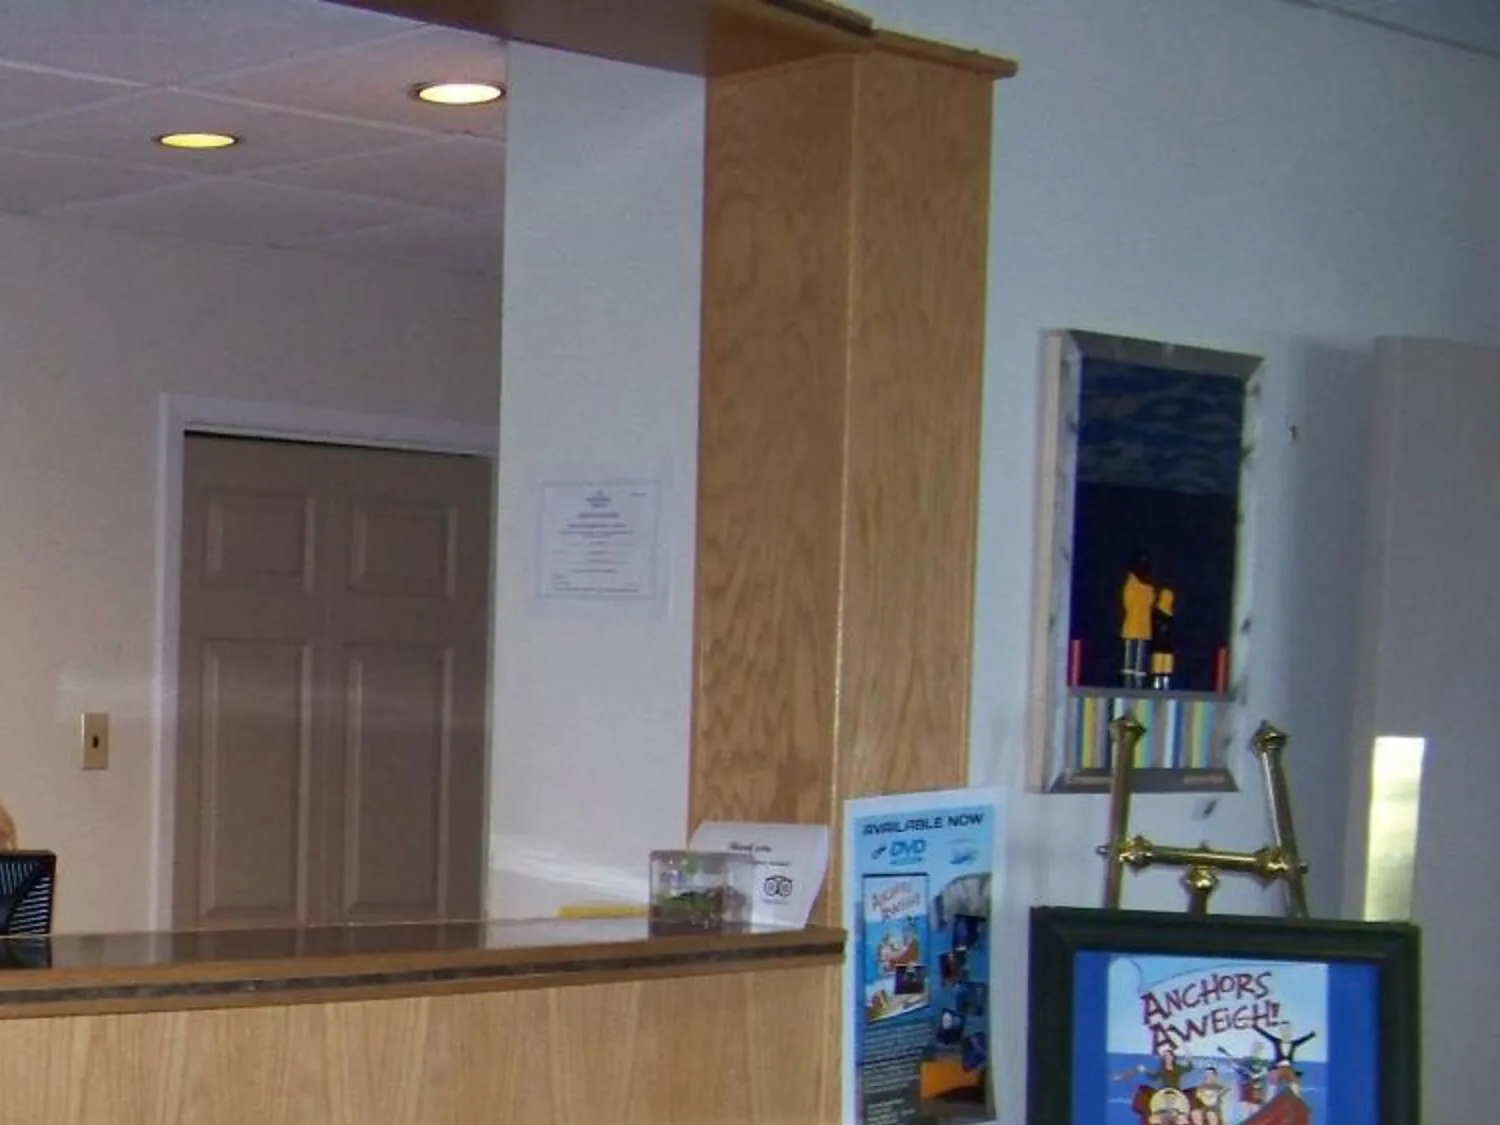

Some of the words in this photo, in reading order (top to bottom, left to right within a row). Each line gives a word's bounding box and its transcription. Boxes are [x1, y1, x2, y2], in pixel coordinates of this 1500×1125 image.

[862, 817, 943, 835] AVAILABLE
[948, 811, 985, 827] NOW
[889, 838, 927, 857] DVD
[1140, 970, 1273, 1026] ANCHORS
